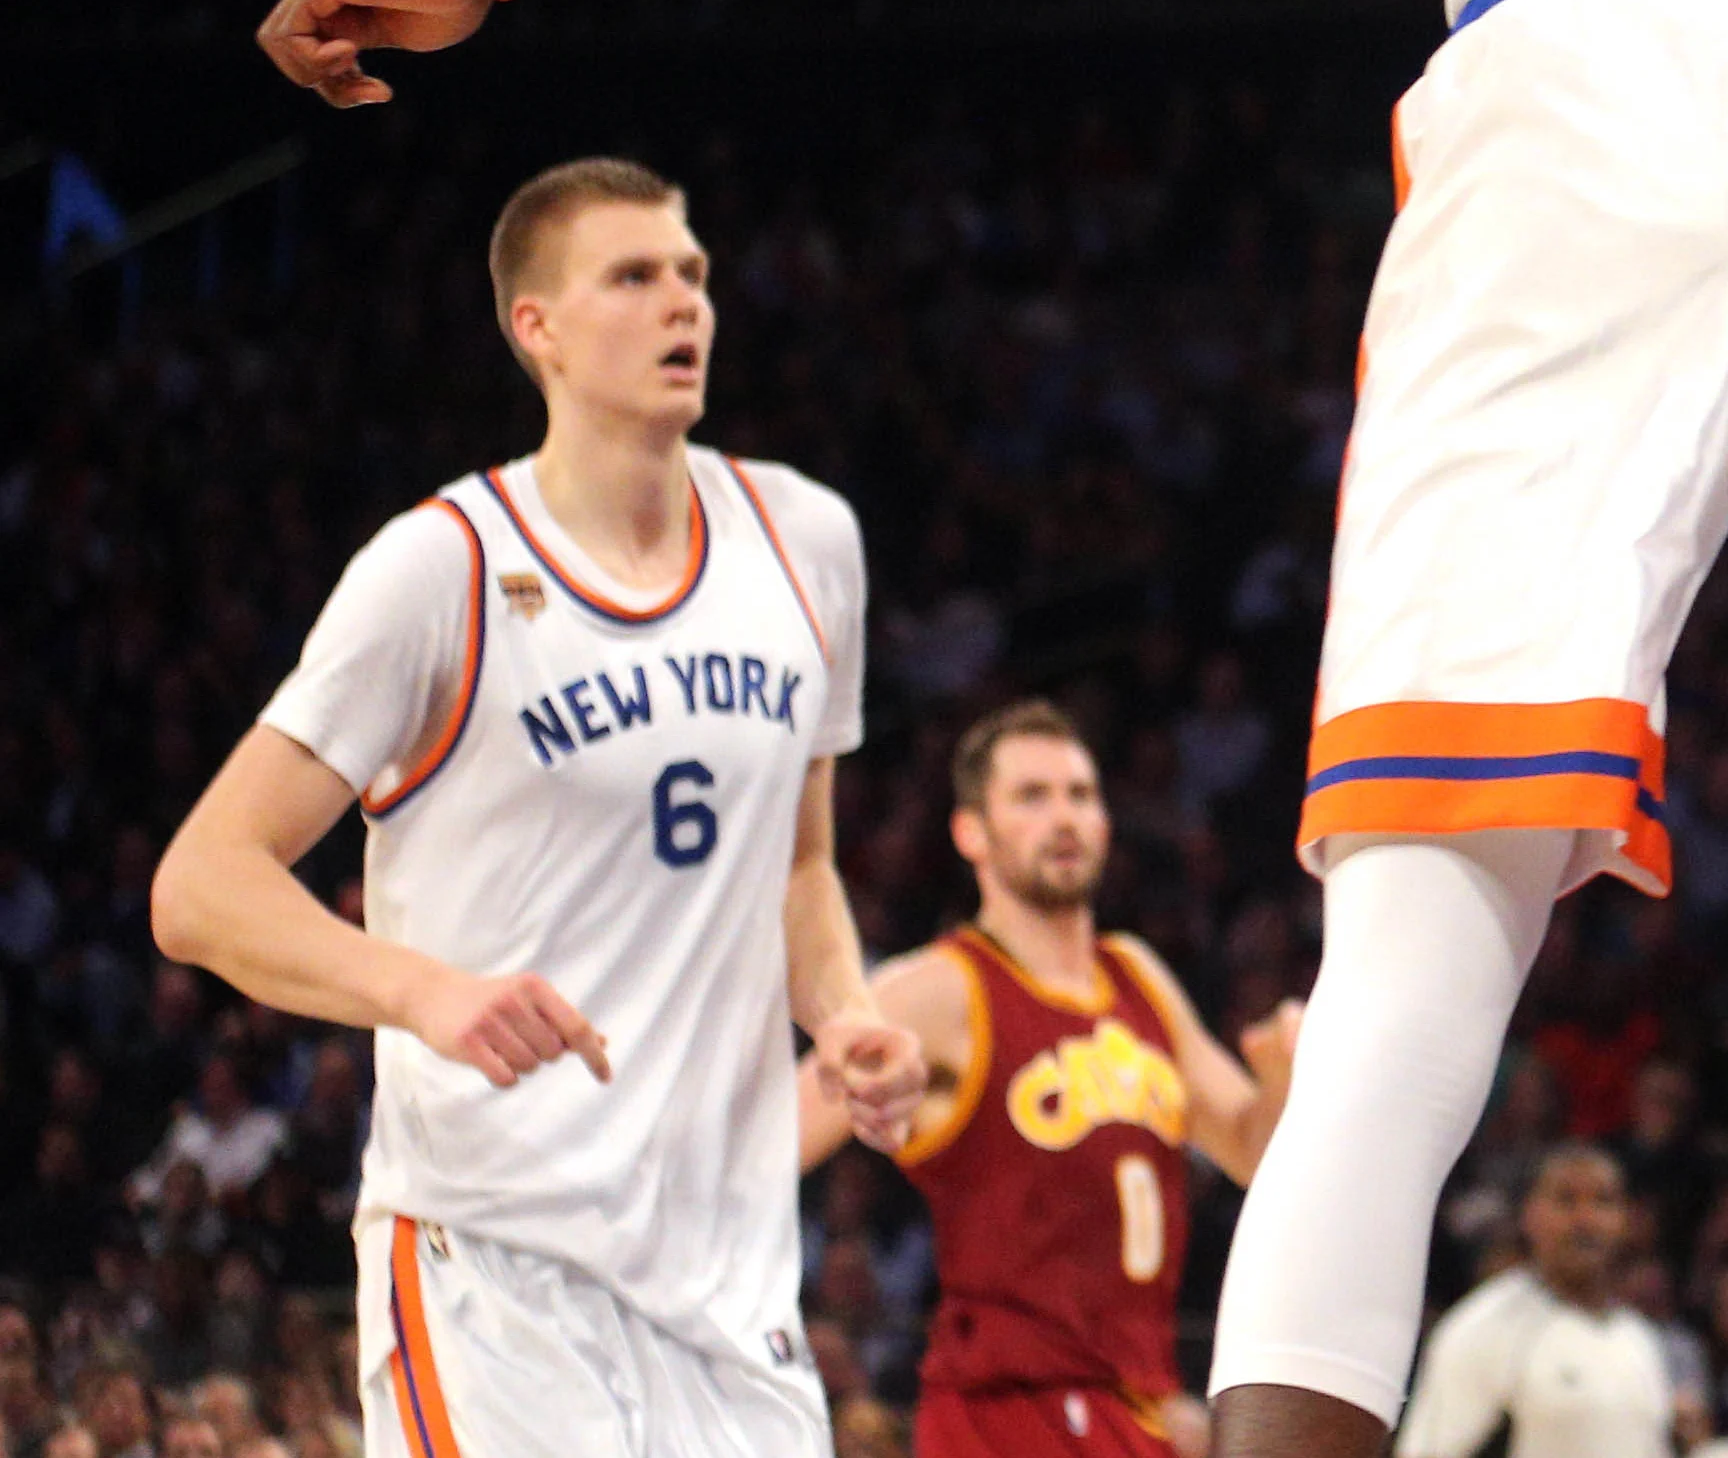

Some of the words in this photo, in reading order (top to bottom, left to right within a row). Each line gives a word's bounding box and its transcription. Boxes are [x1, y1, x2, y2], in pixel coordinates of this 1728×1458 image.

[518, 666, 652, 765] NEW
[664, 652, 802, 737] YORK
[653, 760, 718, 868] 6
